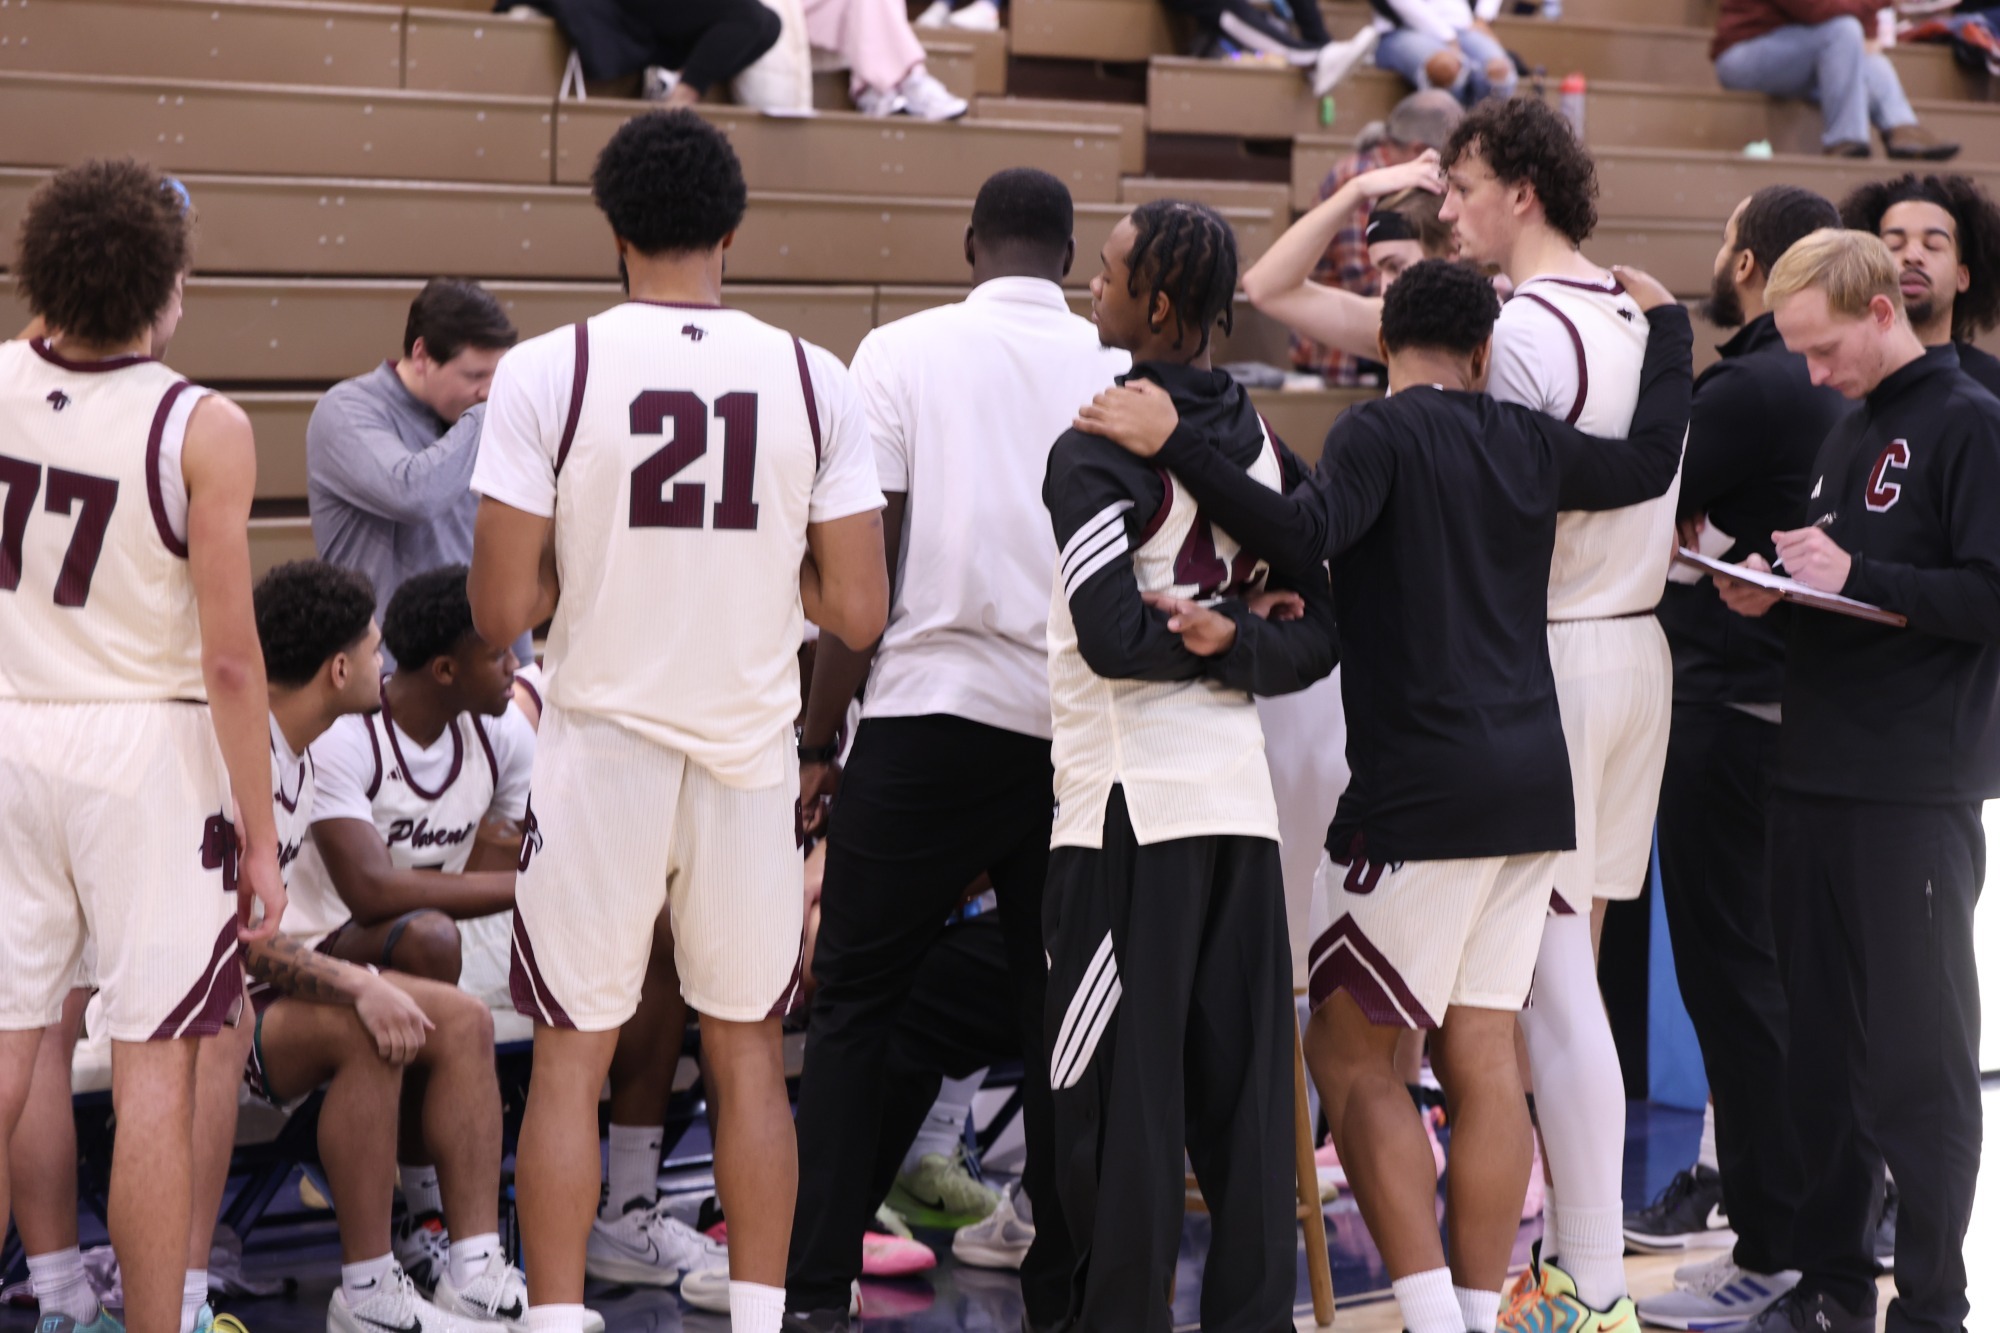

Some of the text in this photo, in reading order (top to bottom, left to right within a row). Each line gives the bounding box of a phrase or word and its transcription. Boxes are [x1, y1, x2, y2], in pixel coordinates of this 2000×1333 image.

[629, 389, 759, 530] 21
[1865, 438, 1911, 513] C
[0, 454, 119, 608] 77
